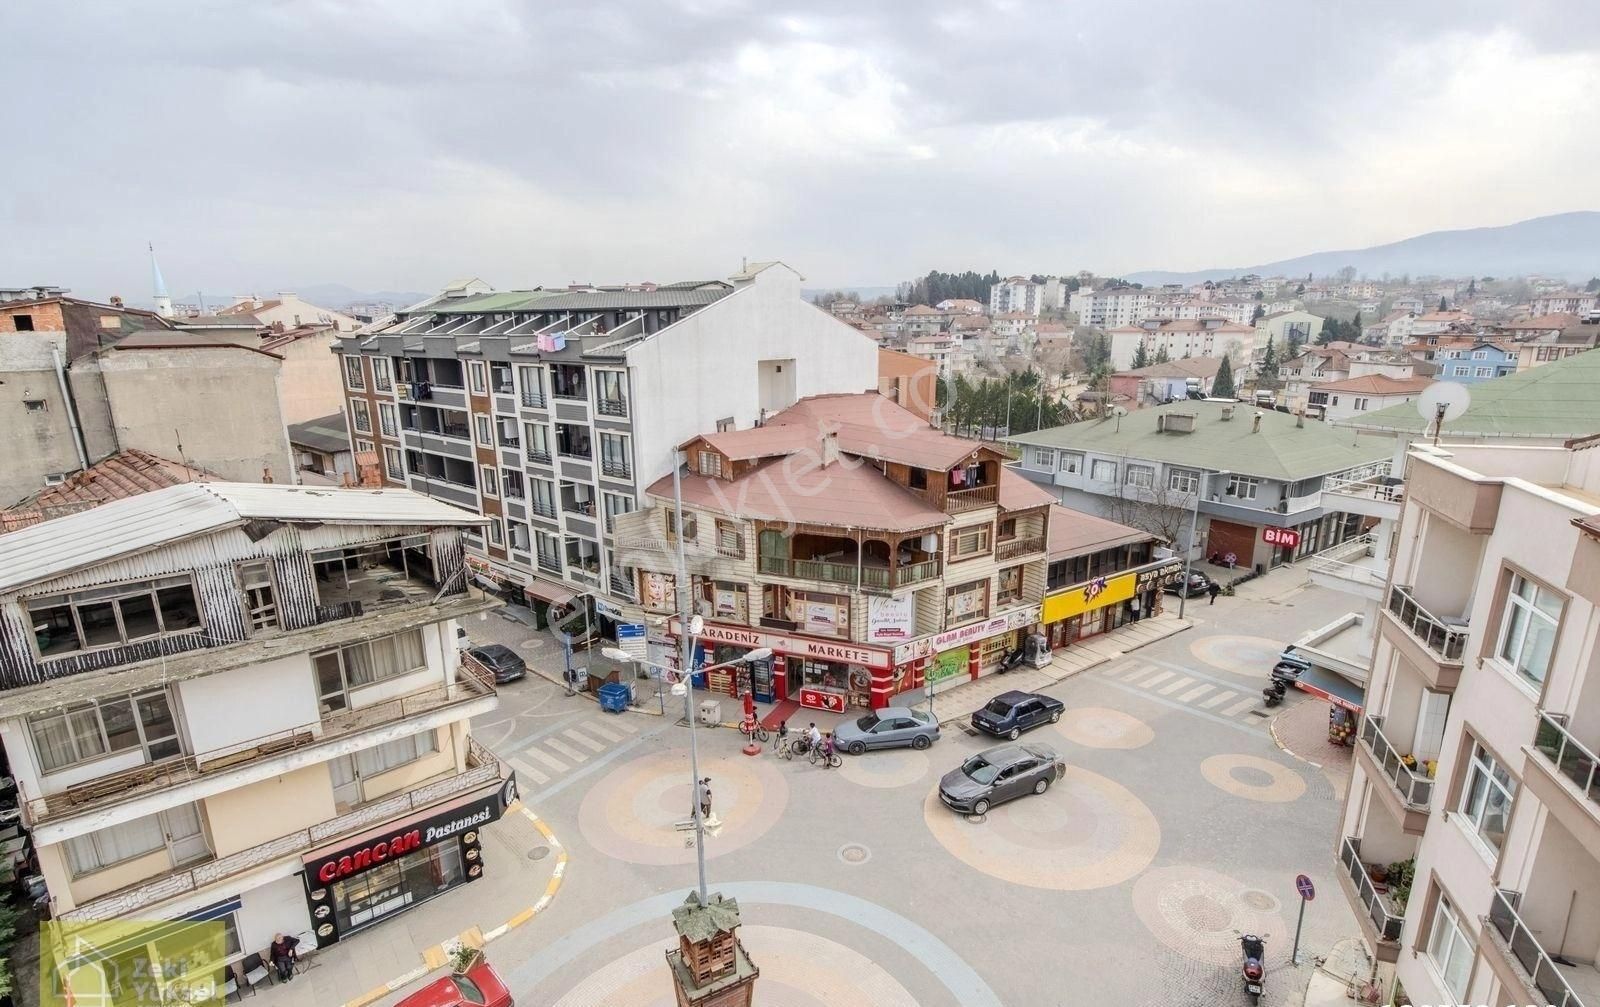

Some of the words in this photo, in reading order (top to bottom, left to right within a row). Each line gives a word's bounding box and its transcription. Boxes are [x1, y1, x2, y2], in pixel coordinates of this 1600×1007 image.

[1265, 529, 1294, 545] BİM
[697, 626, 760, 645] ARADENİZ
[808, 644, 859, 660] MARKET
[936, 632, 957, 645] GLAM
[959, 624, 986, 638] BEAUTY
[425, 806, 491, 843] Pastanesi
